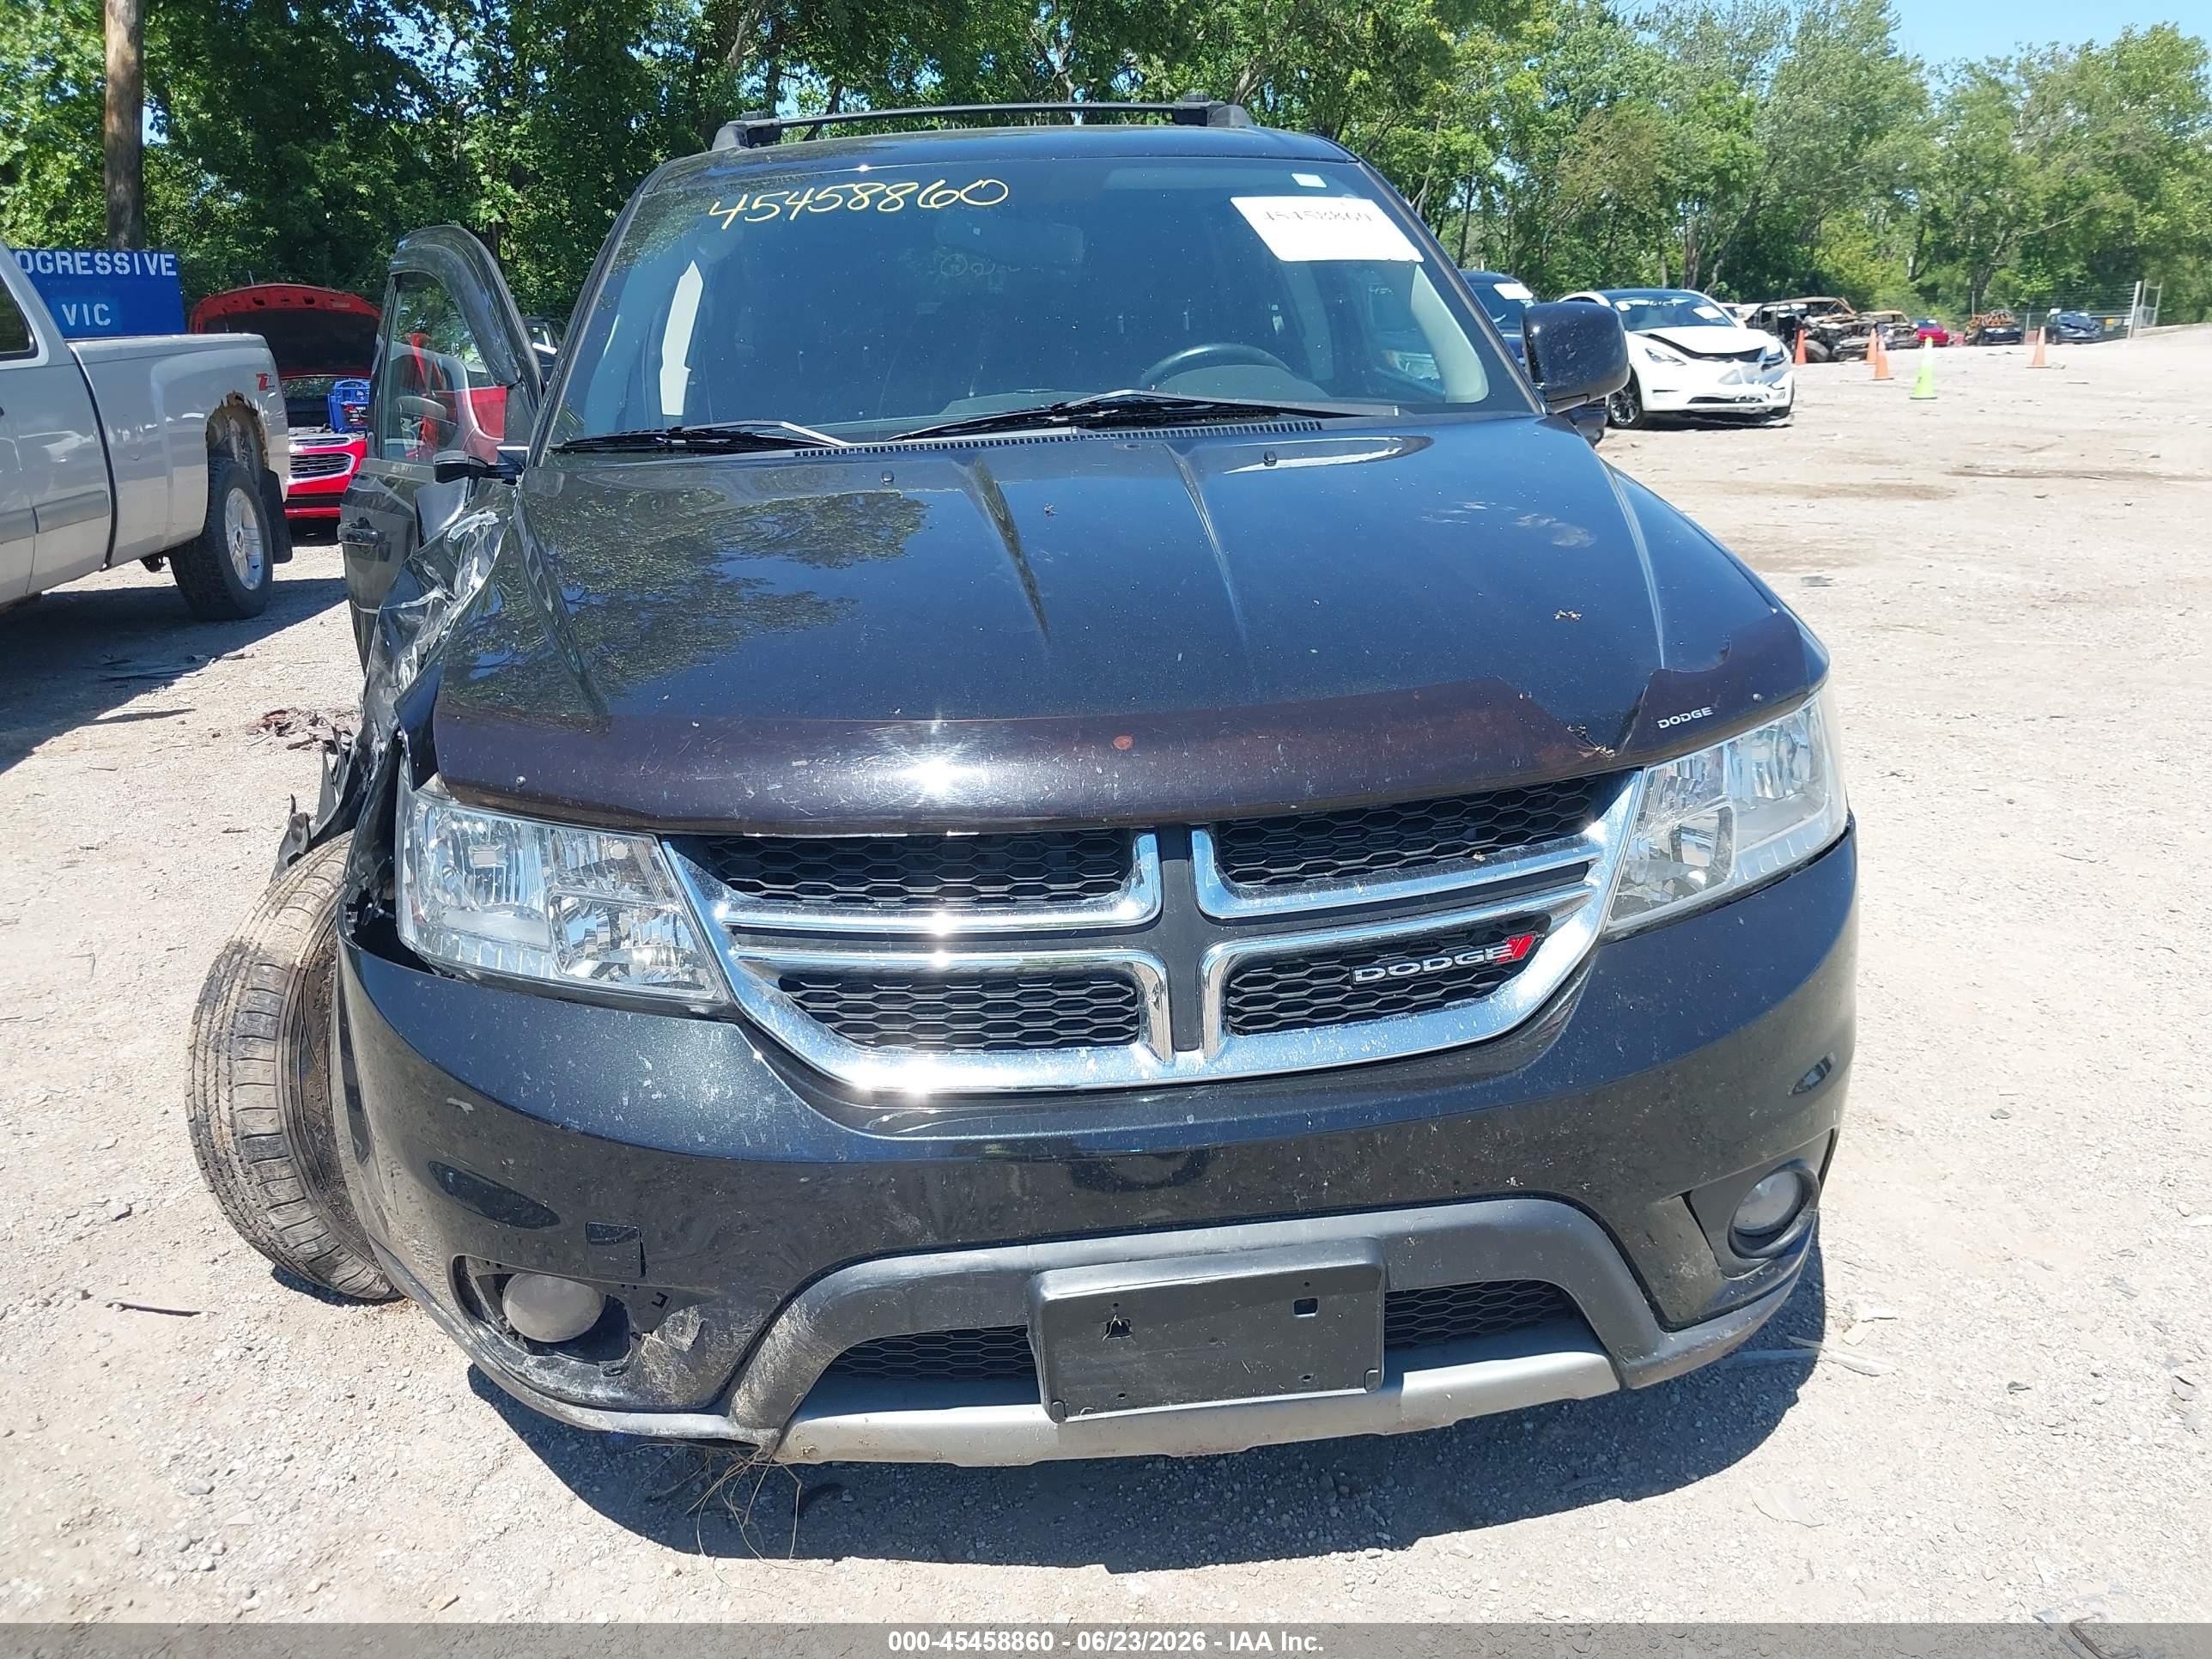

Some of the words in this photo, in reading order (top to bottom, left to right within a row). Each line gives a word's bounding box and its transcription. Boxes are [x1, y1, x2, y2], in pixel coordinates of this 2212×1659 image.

[708, 179, 1009, 230] 45458860
[61, 303, 112, 327] VIC
[1656, 707, 1715, 729] DODGE
[1354, 944, 1514, 983] DODGE
